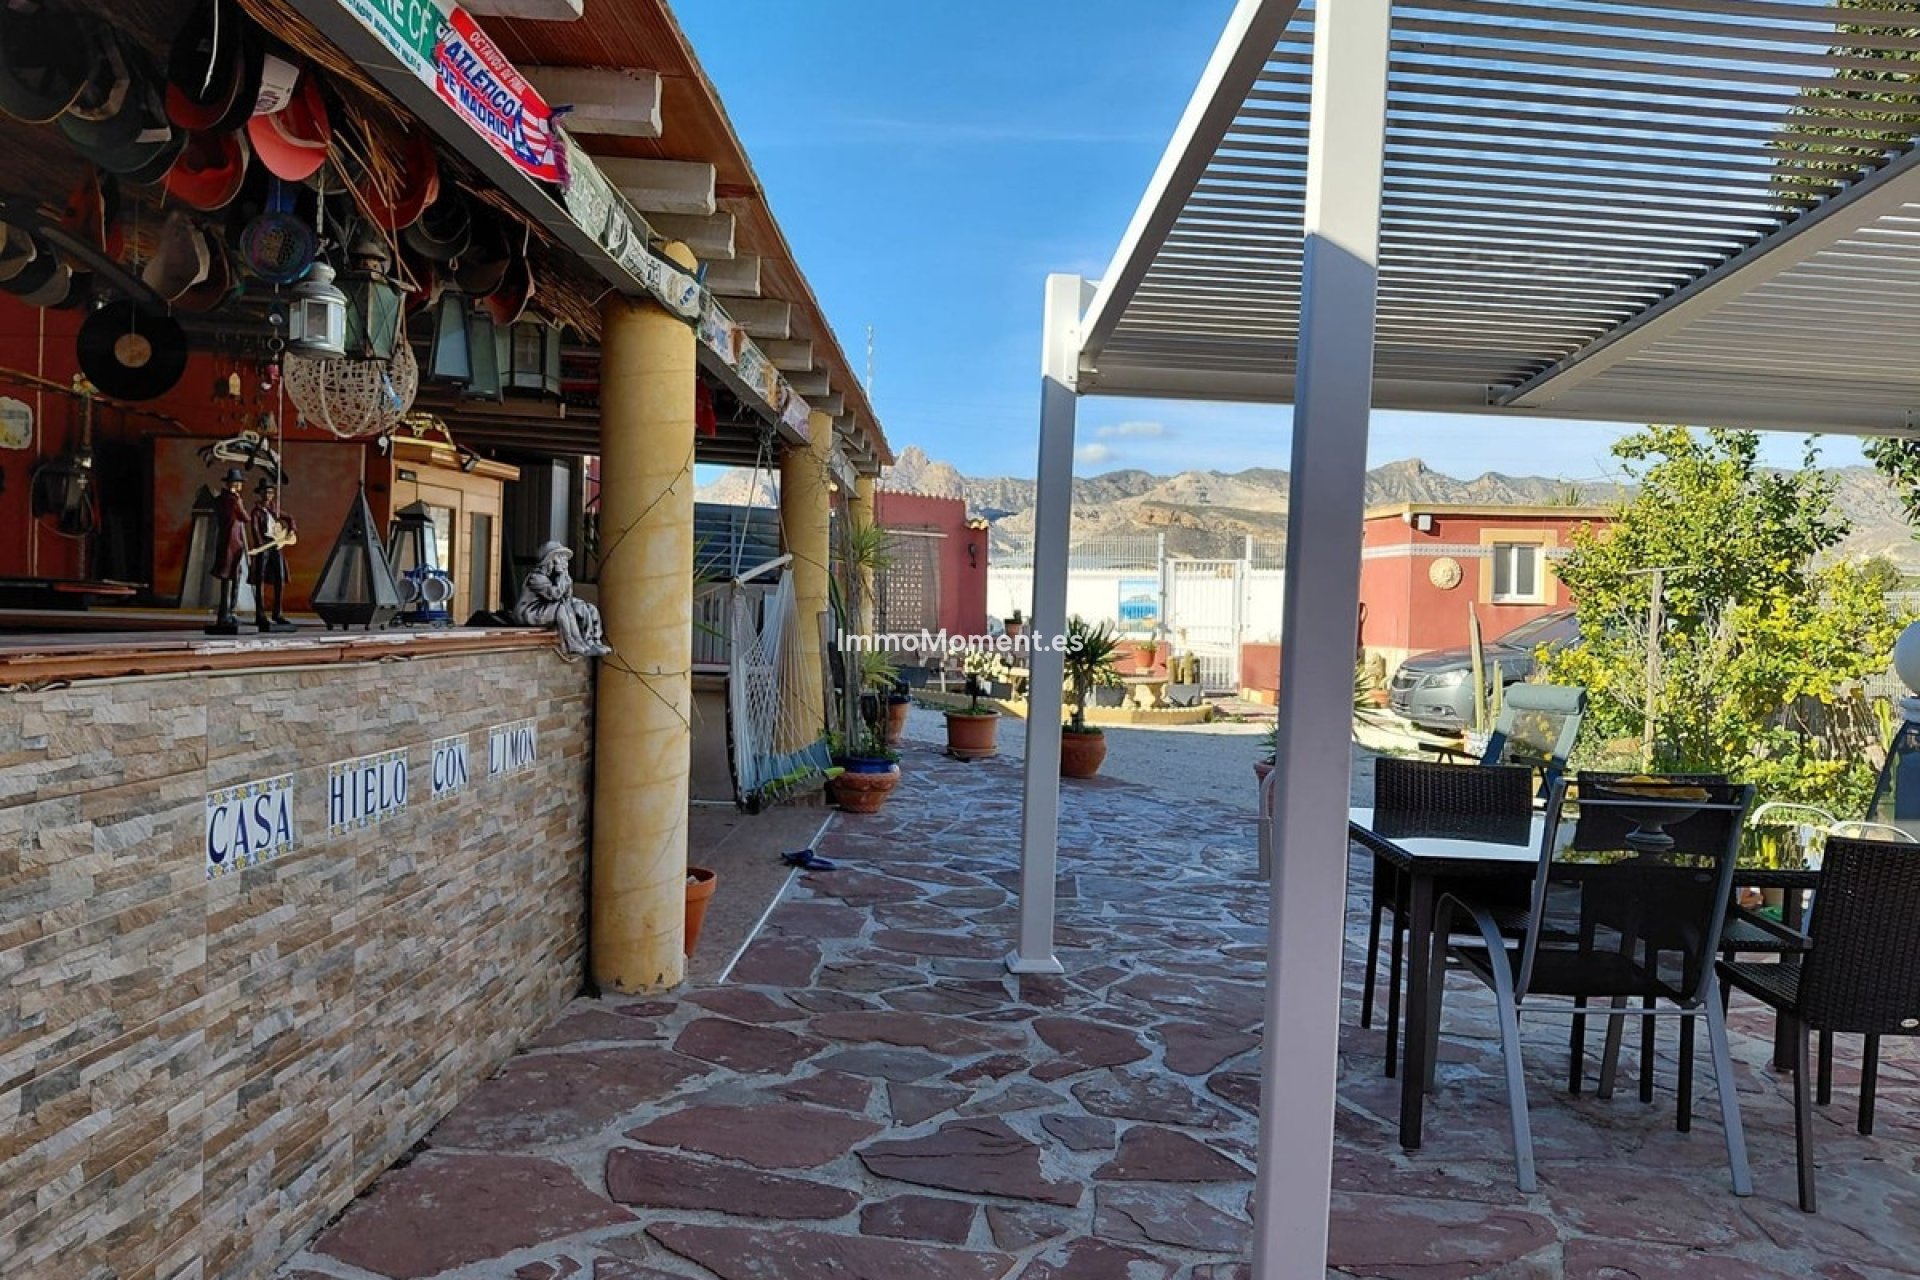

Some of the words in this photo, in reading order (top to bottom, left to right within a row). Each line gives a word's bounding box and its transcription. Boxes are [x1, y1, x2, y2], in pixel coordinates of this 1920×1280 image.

[445, 39, 516, 118] ATLÉTICO
[469, 31, 506, 72] OCTAVOS
[439, 60, 457, 95] DE
[459, 84, 511, 141] MADRID
[207, 790, 291, 865] CASA
[330, 761, 406, 826] HIELO
[432, 746, 468, 792] CON
